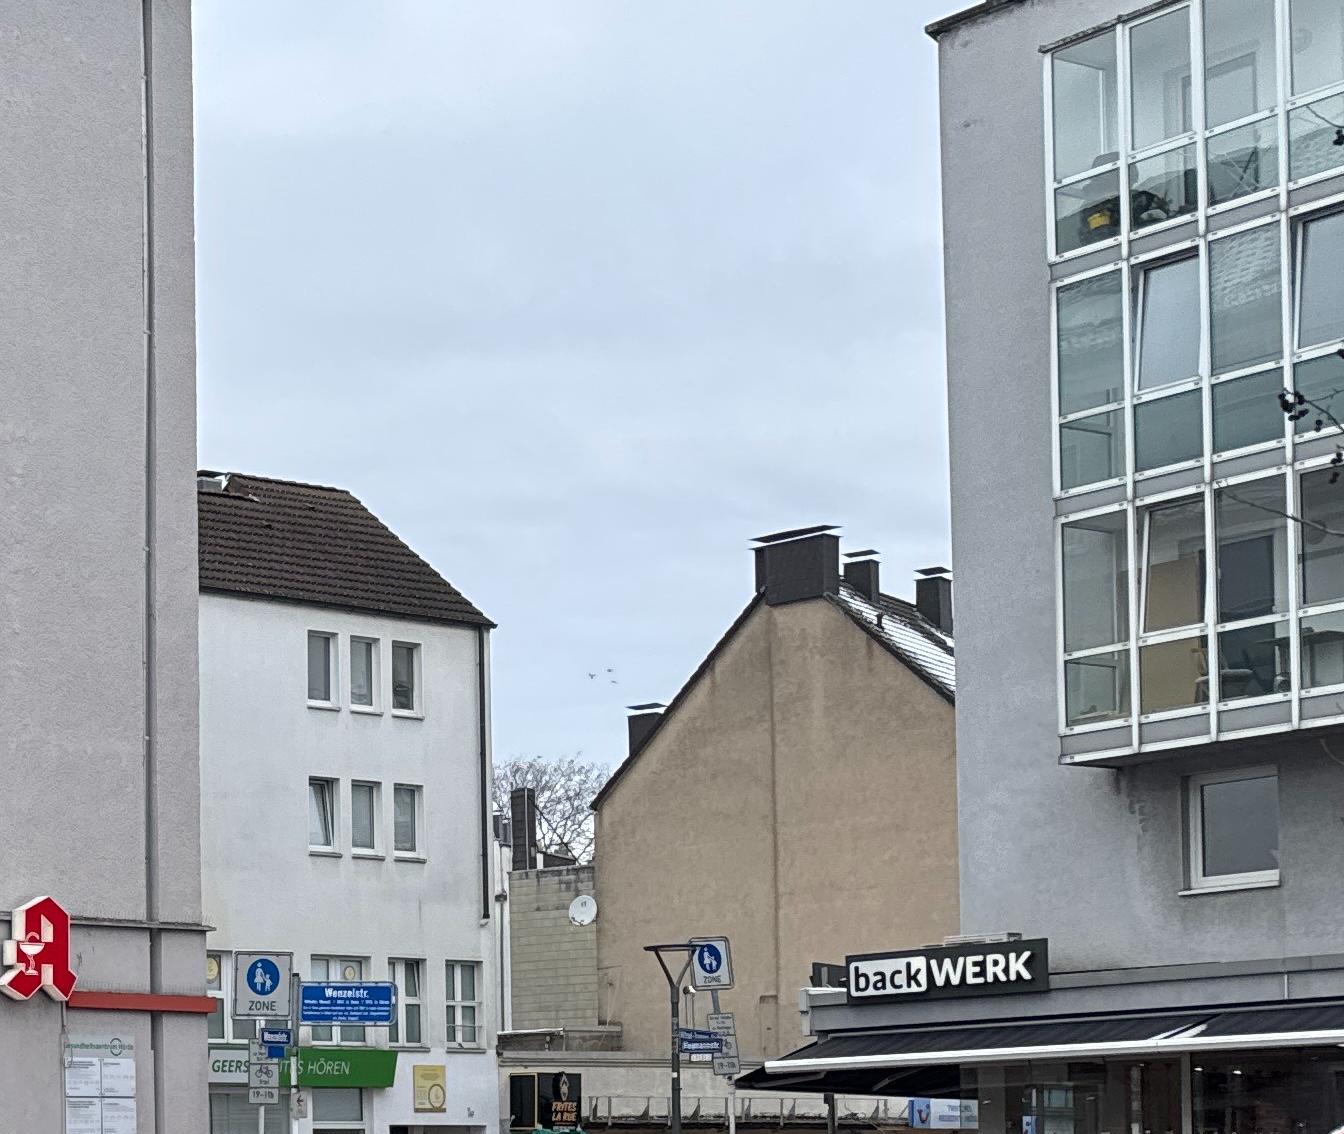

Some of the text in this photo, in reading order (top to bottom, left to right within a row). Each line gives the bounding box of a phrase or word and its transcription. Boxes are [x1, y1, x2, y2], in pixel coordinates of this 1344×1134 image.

[248, 1000, 277, 1011] ZONE
[212, 1059, 249, 1073] GEERS
[307, 1058, 351, 1075] HÖREN
